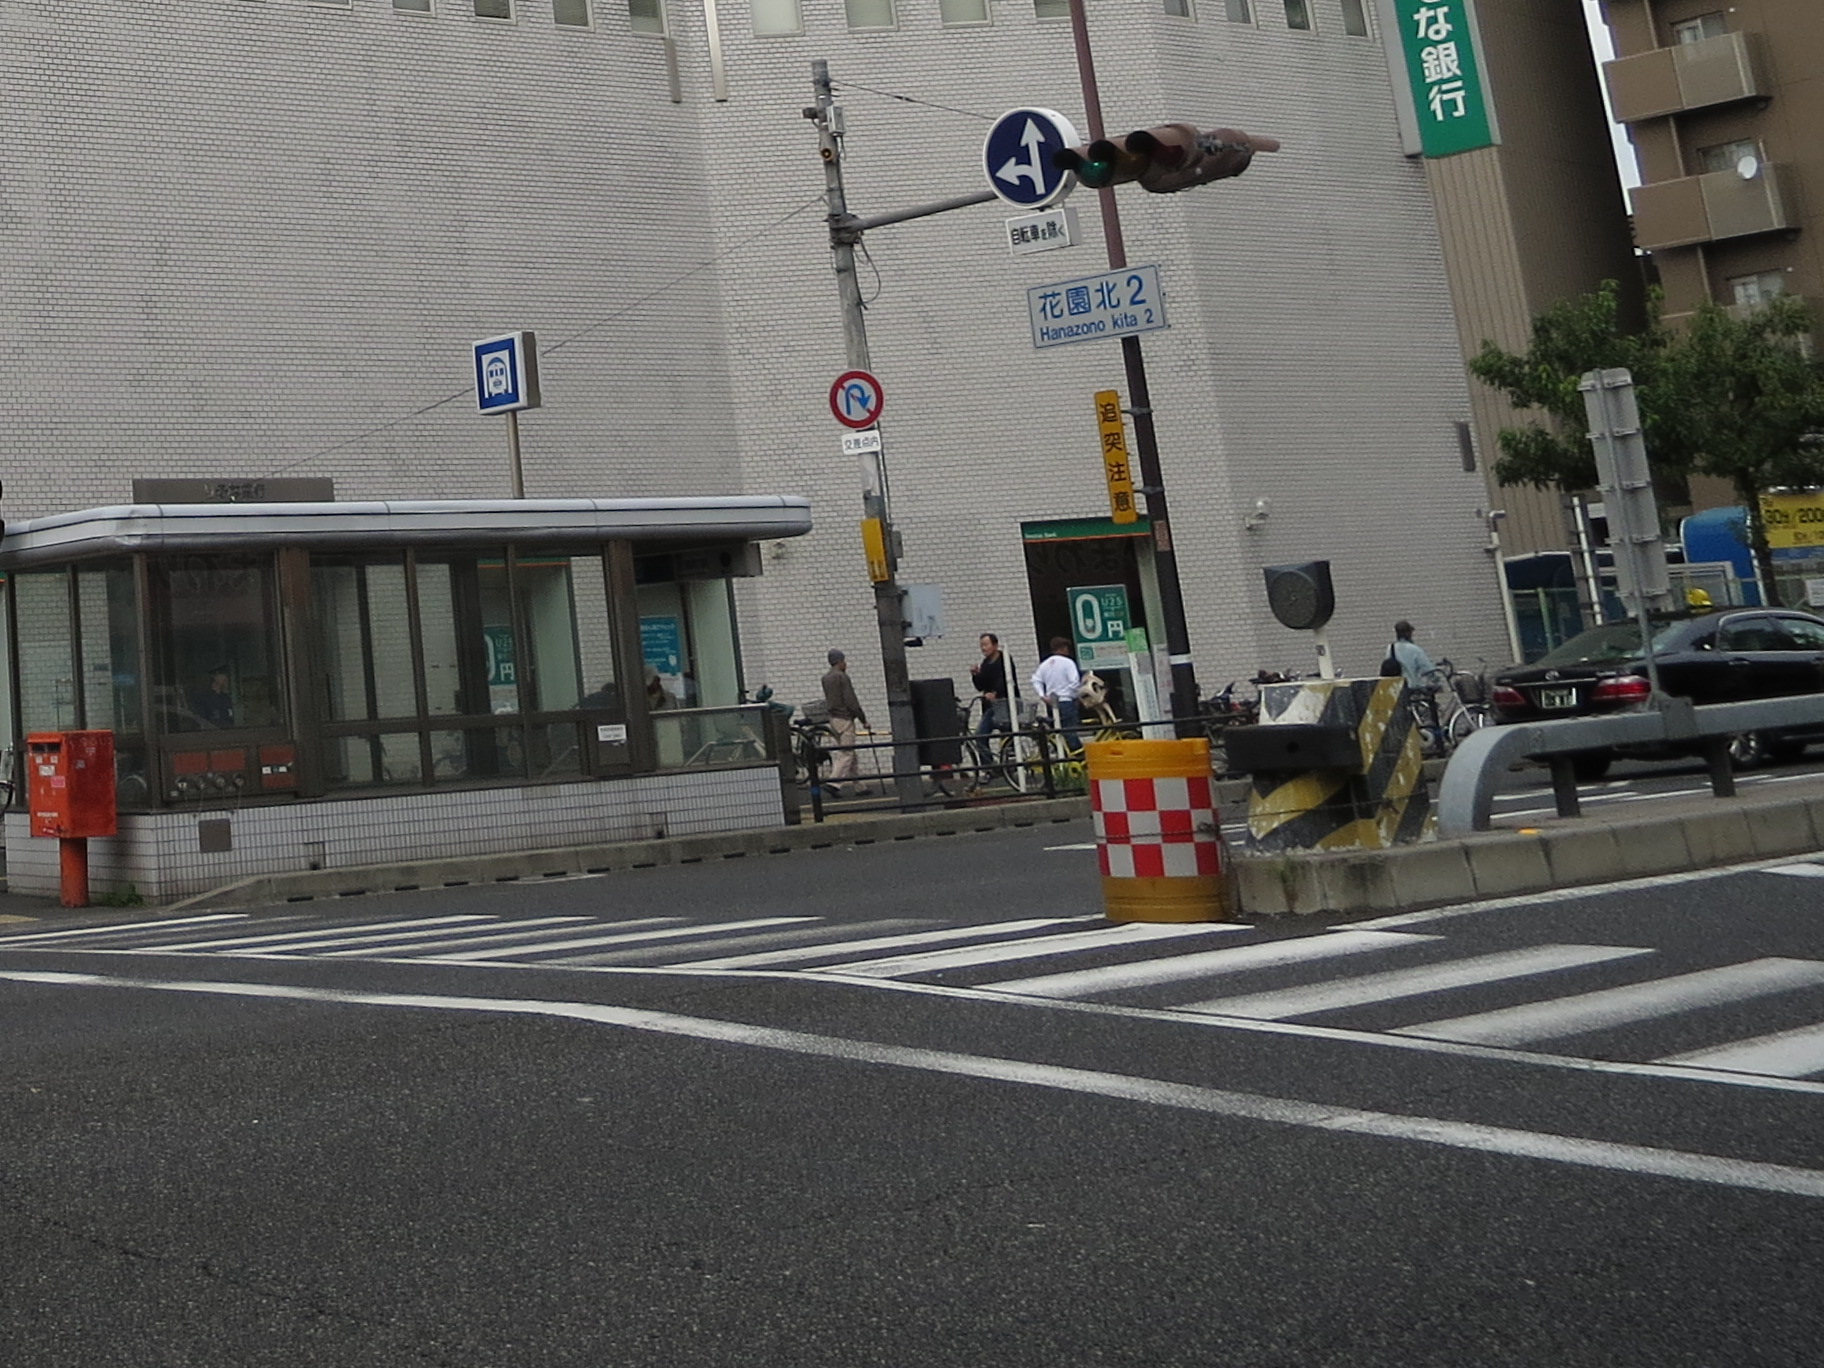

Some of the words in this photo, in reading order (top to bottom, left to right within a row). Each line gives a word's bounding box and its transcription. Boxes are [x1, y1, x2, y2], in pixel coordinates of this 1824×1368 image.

[1011, 220, 1066, 246] 自転車を除く
[1038, 274, 1147, 321] 花園北2
[1040, 320, 1106, 342] Hanazono
[1111, 312, 1138, 329] kita
[1144, 308, 1154, 324] 2
[1099, 402, 1132, 512] 追突注意
[1107, 619, 1125, 639] 円
